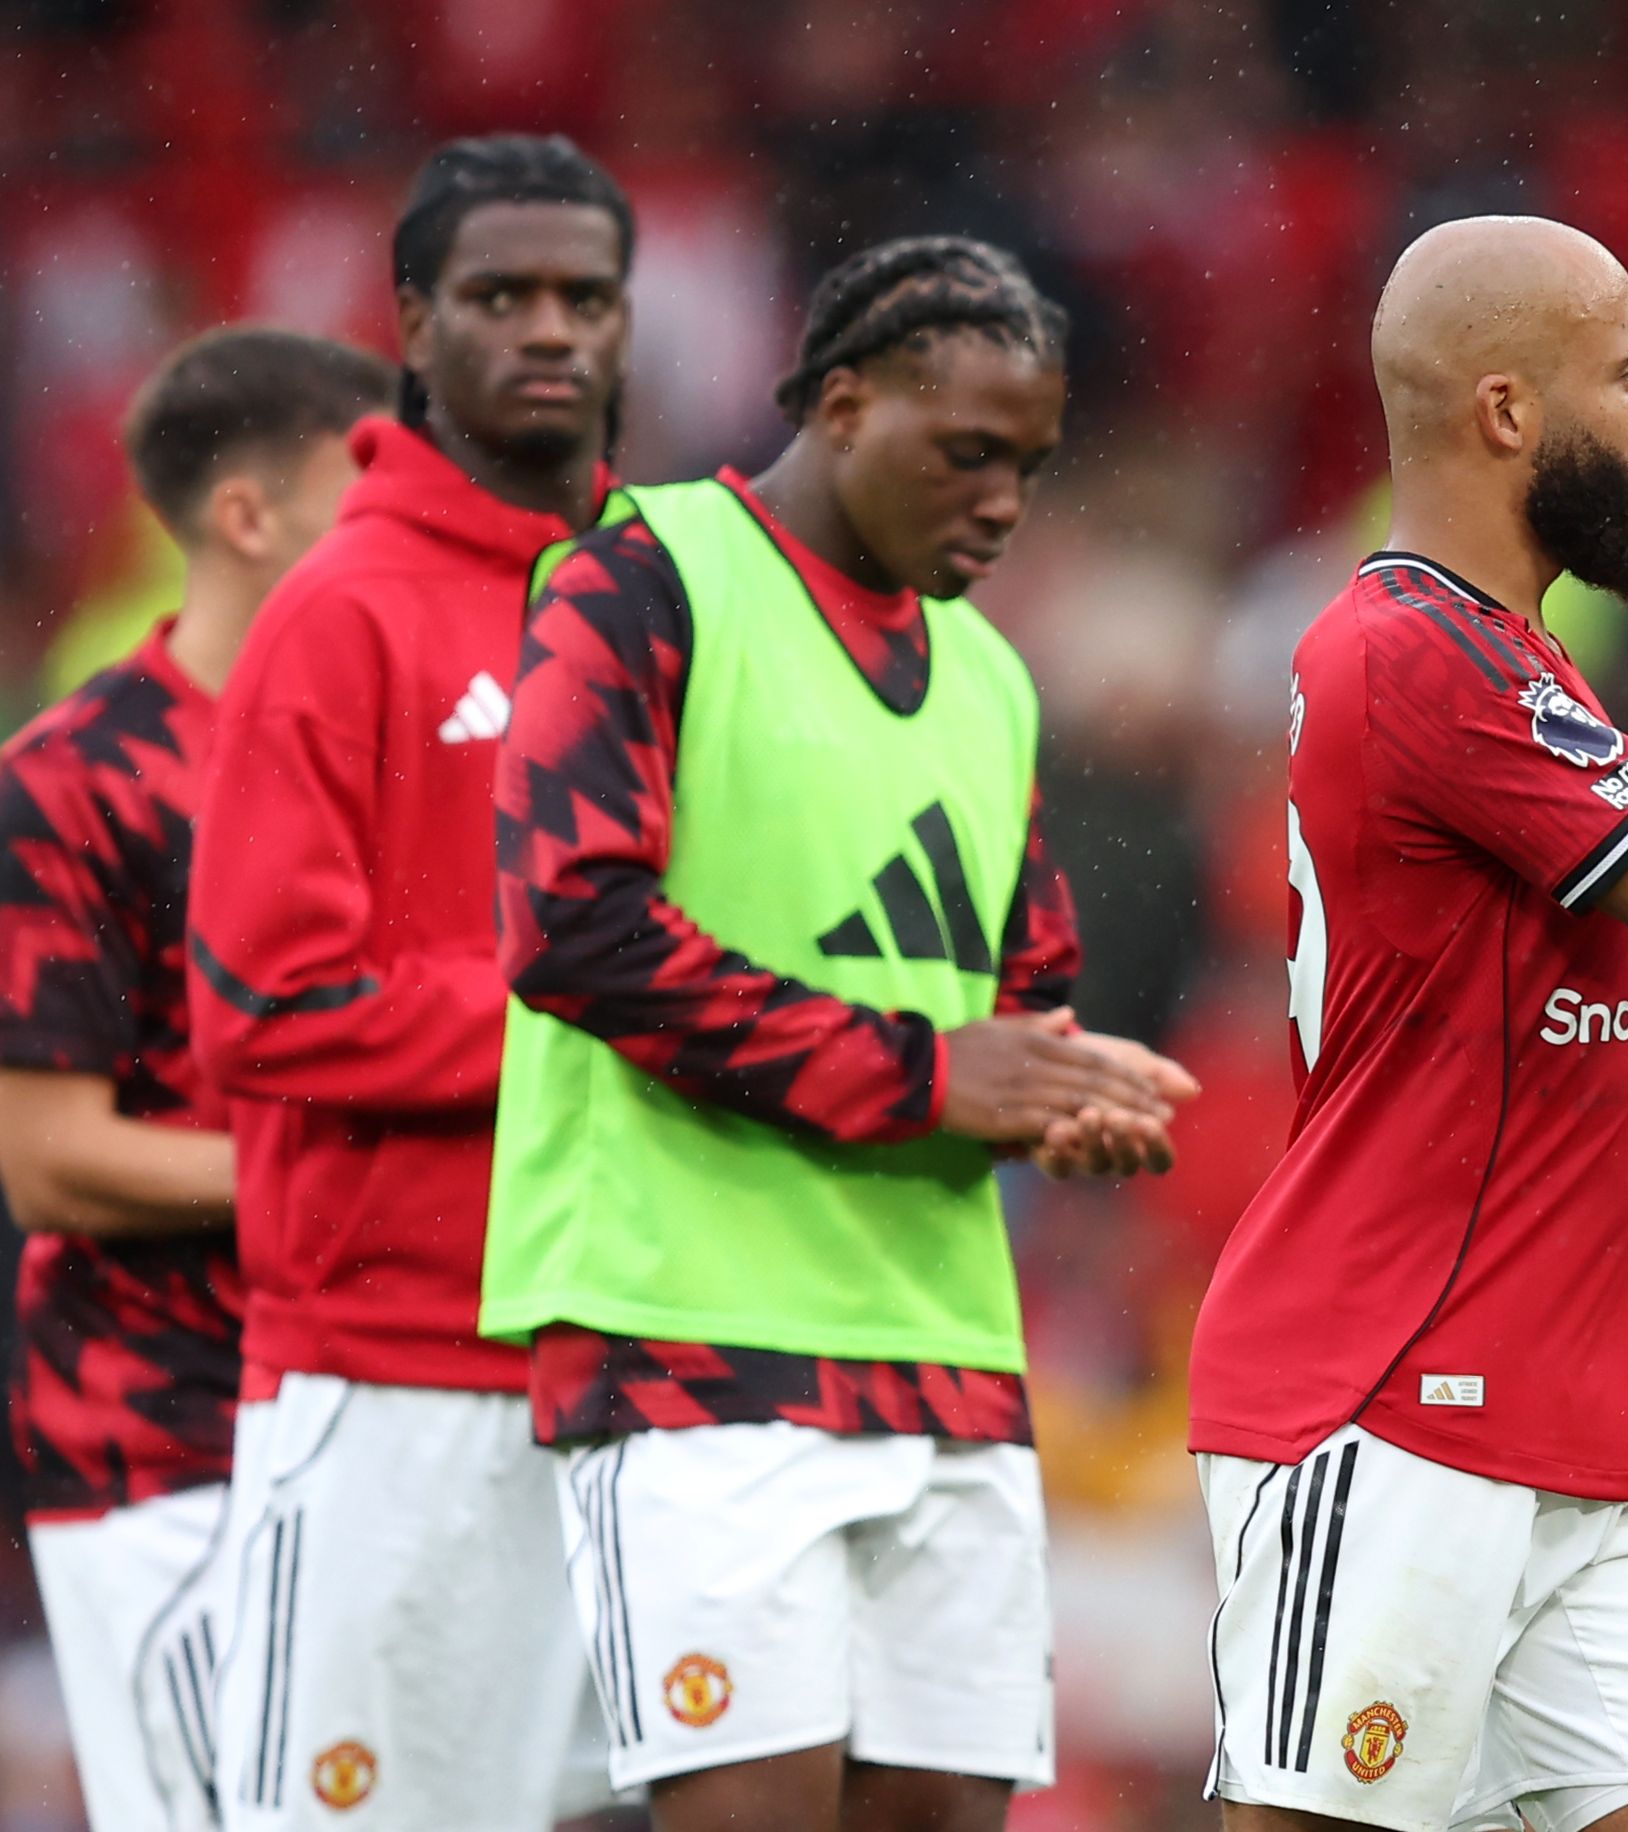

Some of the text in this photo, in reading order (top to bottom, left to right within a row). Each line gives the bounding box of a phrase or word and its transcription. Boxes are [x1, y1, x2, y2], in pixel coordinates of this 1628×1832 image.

[1590, 777, 1624, 799] No
[1352, 1706, 1404, 1736] MANCHESTER
[1351, 1760, 1386, 1778] UNITED
